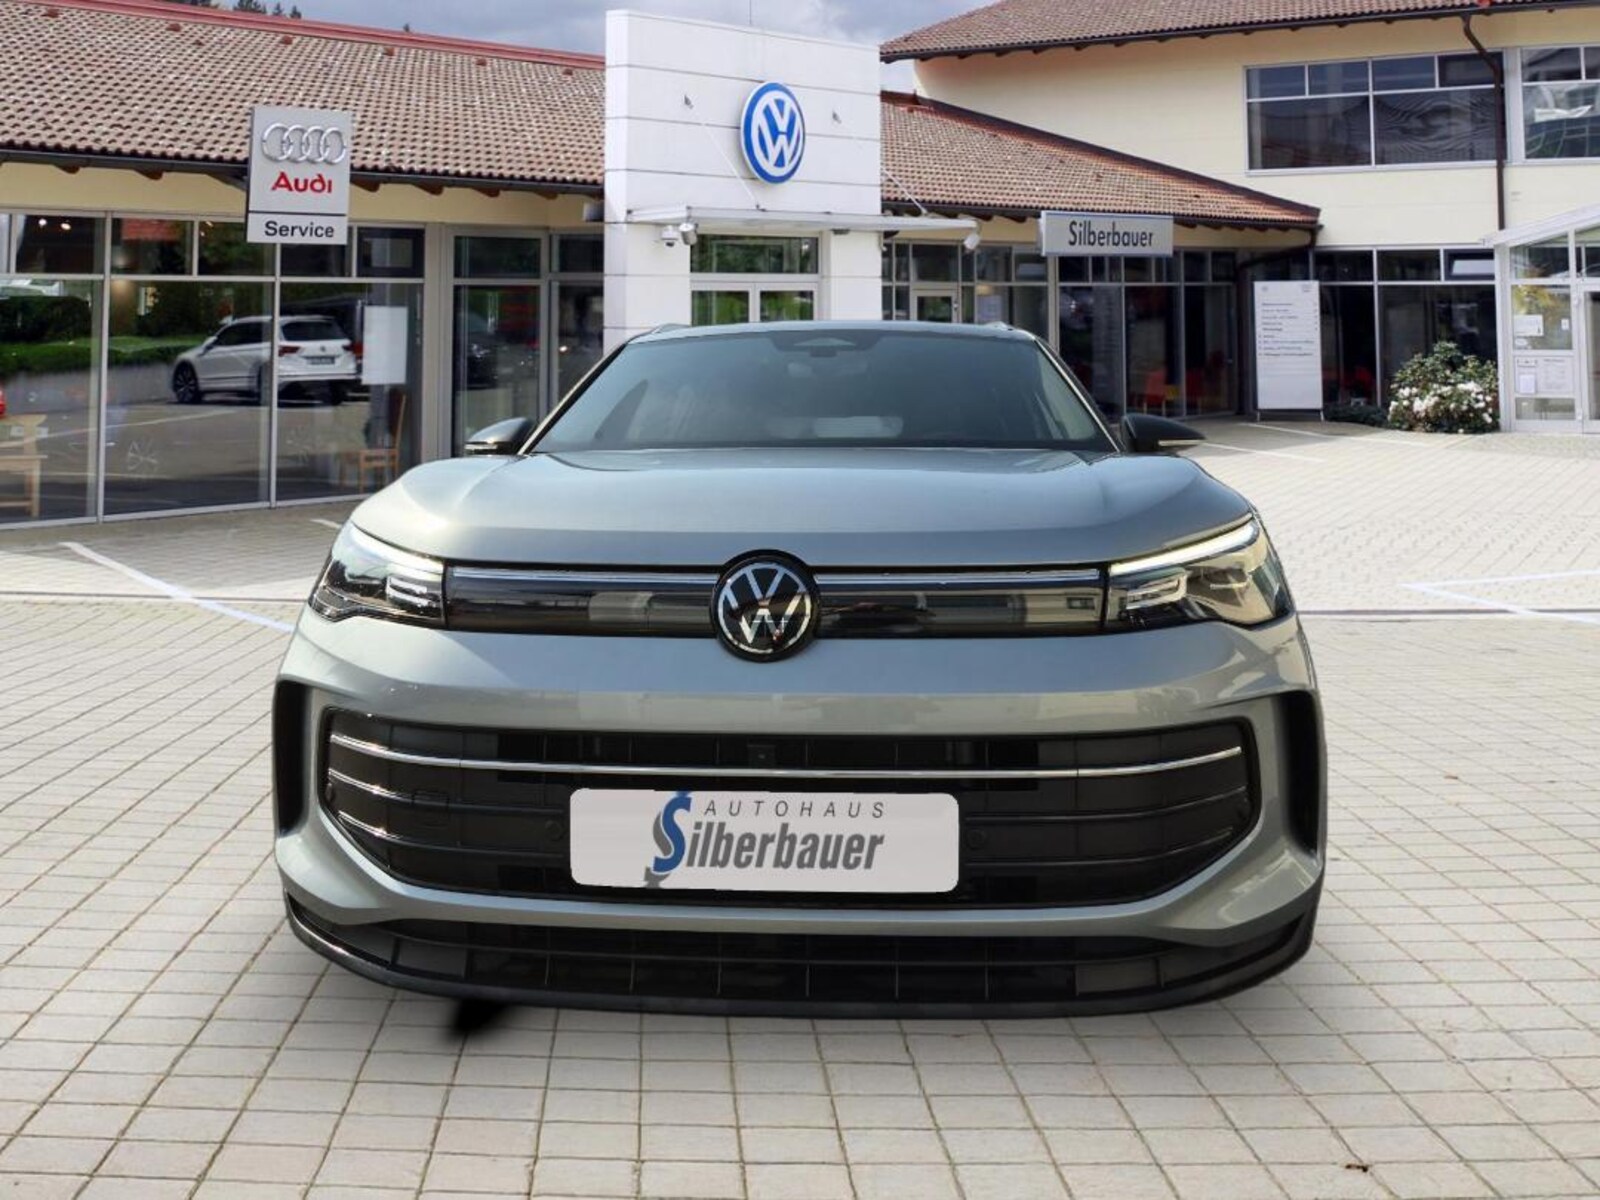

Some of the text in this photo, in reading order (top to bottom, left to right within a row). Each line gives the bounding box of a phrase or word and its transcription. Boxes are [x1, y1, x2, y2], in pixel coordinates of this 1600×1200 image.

[751, 90, 802, 177] VW
[271, 171, 332, 194] Audi
[264, 220, 335, 238] Service
[1068, 219, 1154, 247] Silberbauer
[704, 799, 885, 818] AUTOHAUS
[652, 796, 885, 873] Silberbauer
